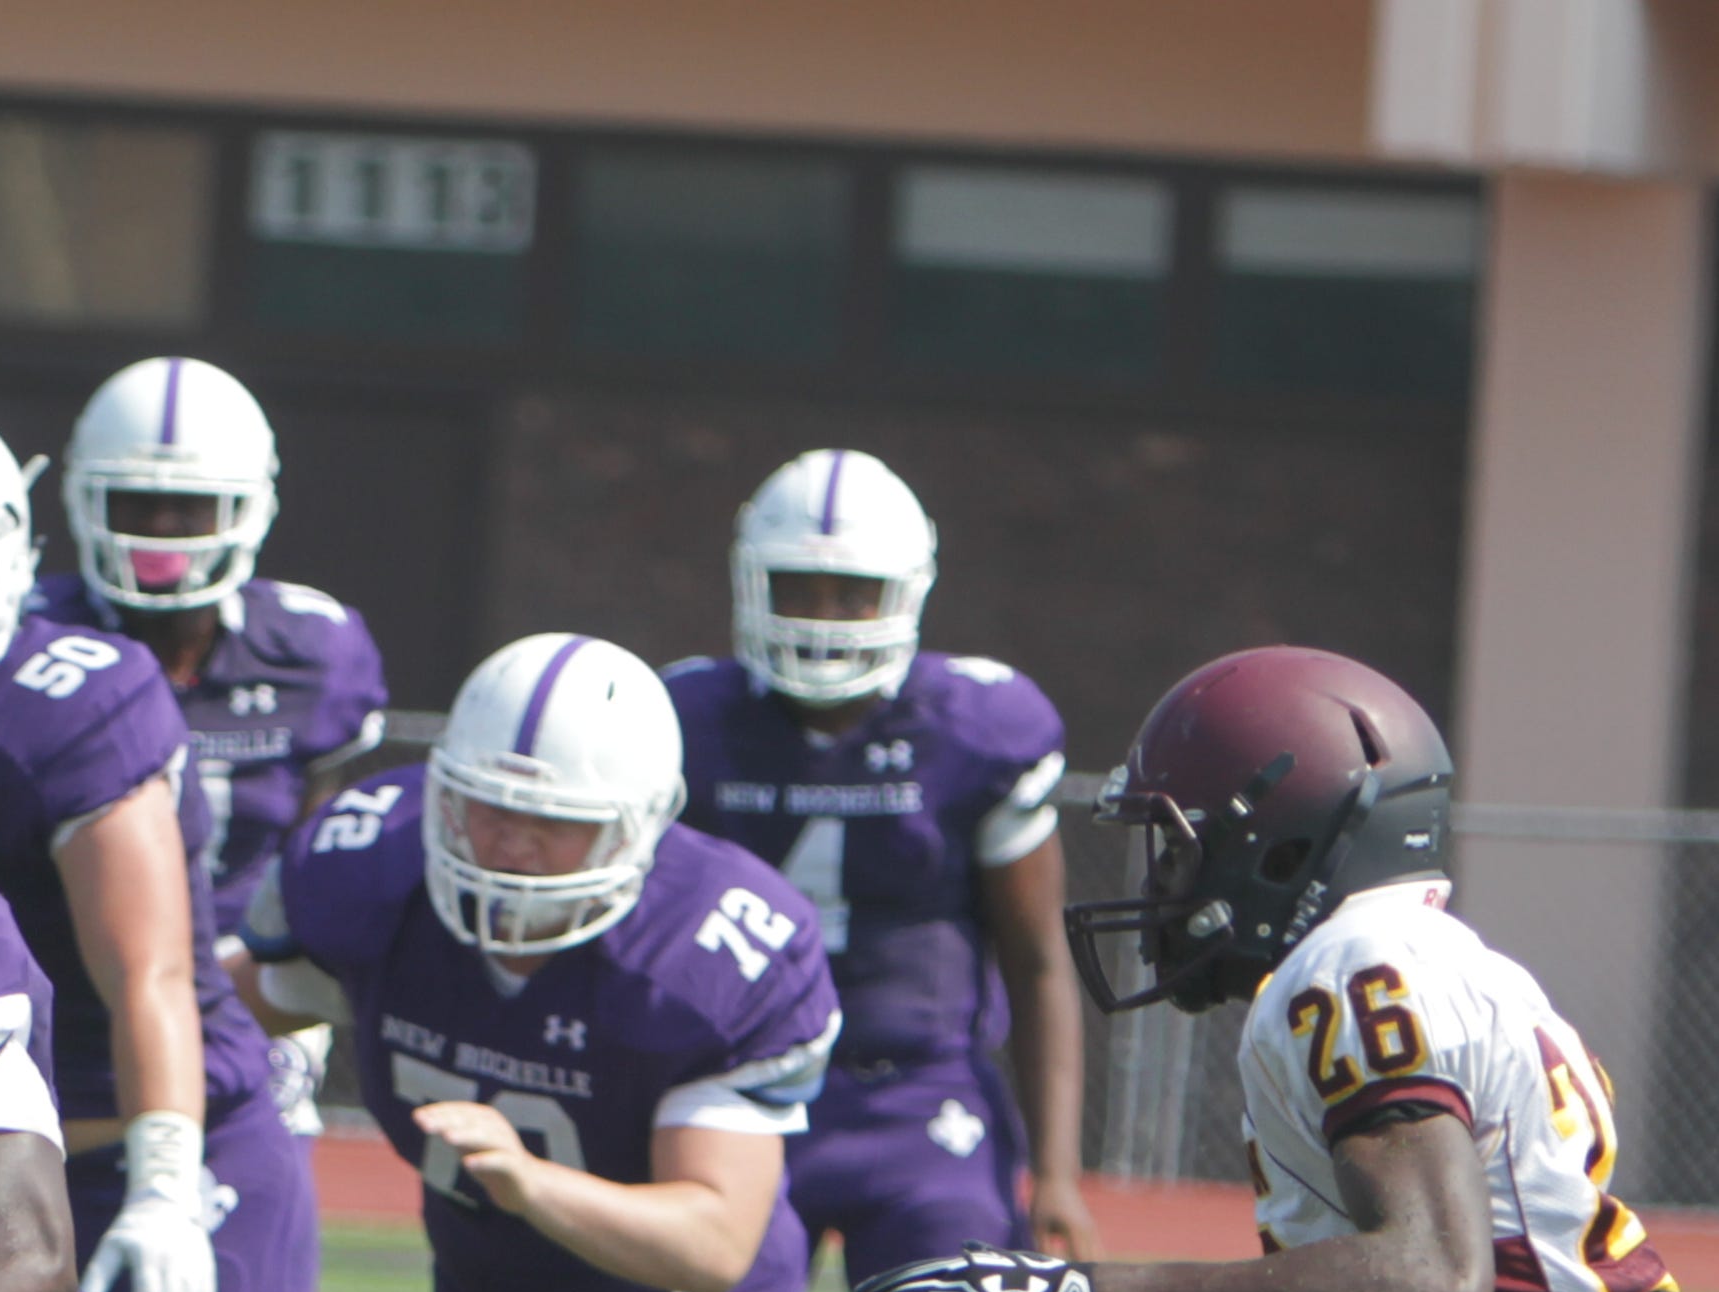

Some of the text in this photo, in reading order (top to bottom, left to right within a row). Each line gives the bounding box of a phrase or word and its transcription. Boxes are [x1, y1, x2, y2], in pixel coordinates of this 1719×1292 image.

[12, 635, 121, 699] 50
[313, 785, 403, 854] 72
[694, 887, 797, 983] 72
[1286, 962, 1429, 1104] 26
